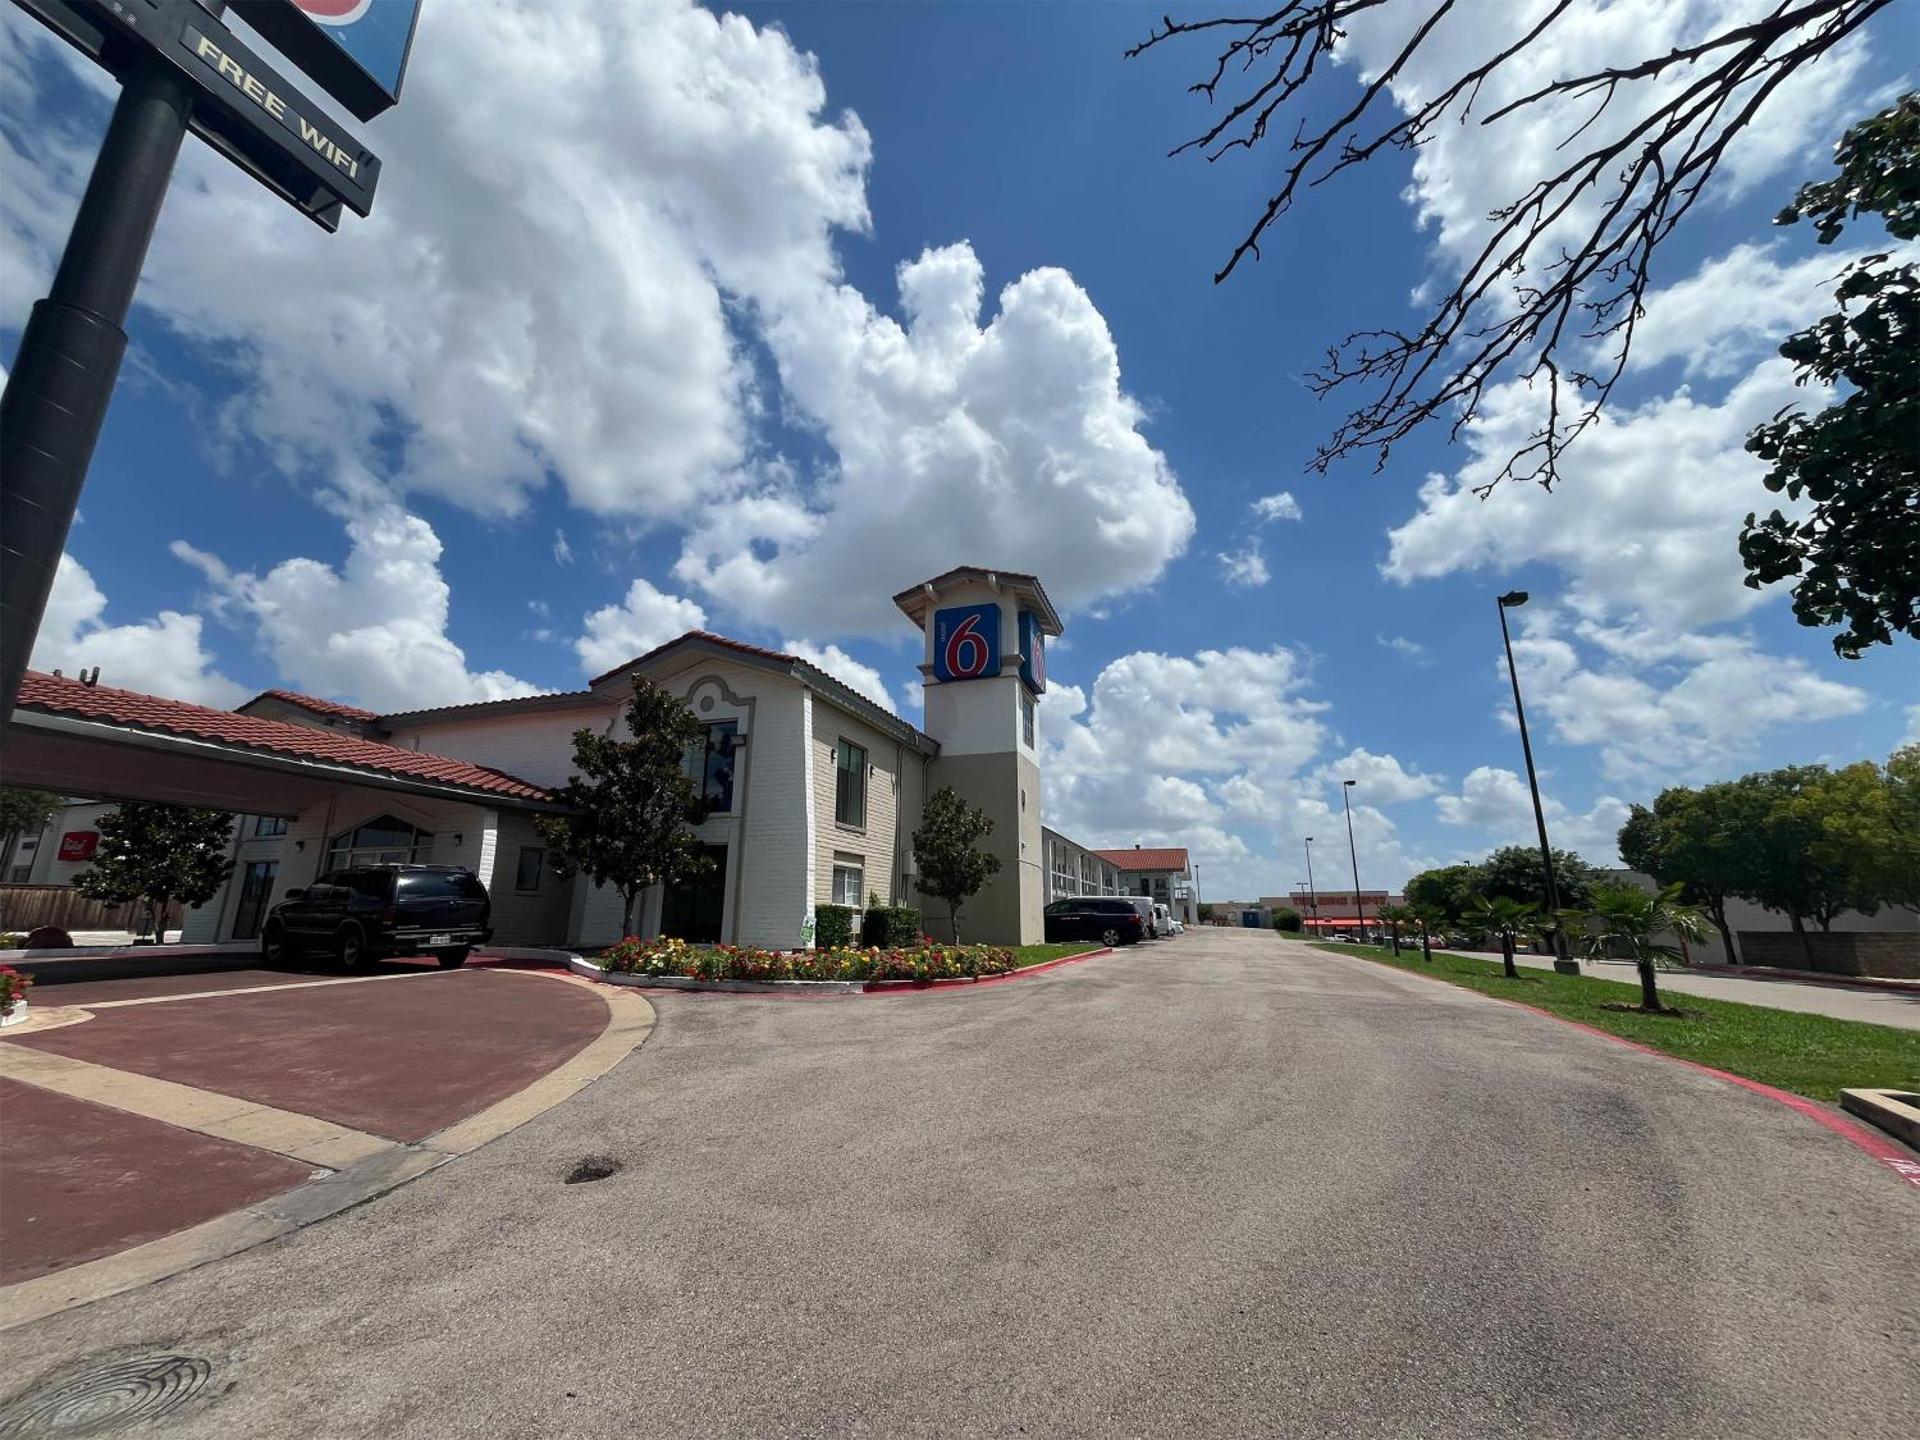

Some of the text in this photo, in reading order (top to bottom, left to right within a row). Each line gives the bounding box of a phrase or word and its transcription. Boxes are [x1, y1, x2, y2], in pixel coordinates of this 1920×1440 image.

[198, 37, 359, 179] FREE WIFI
[945, 613, 989, 678] 6
